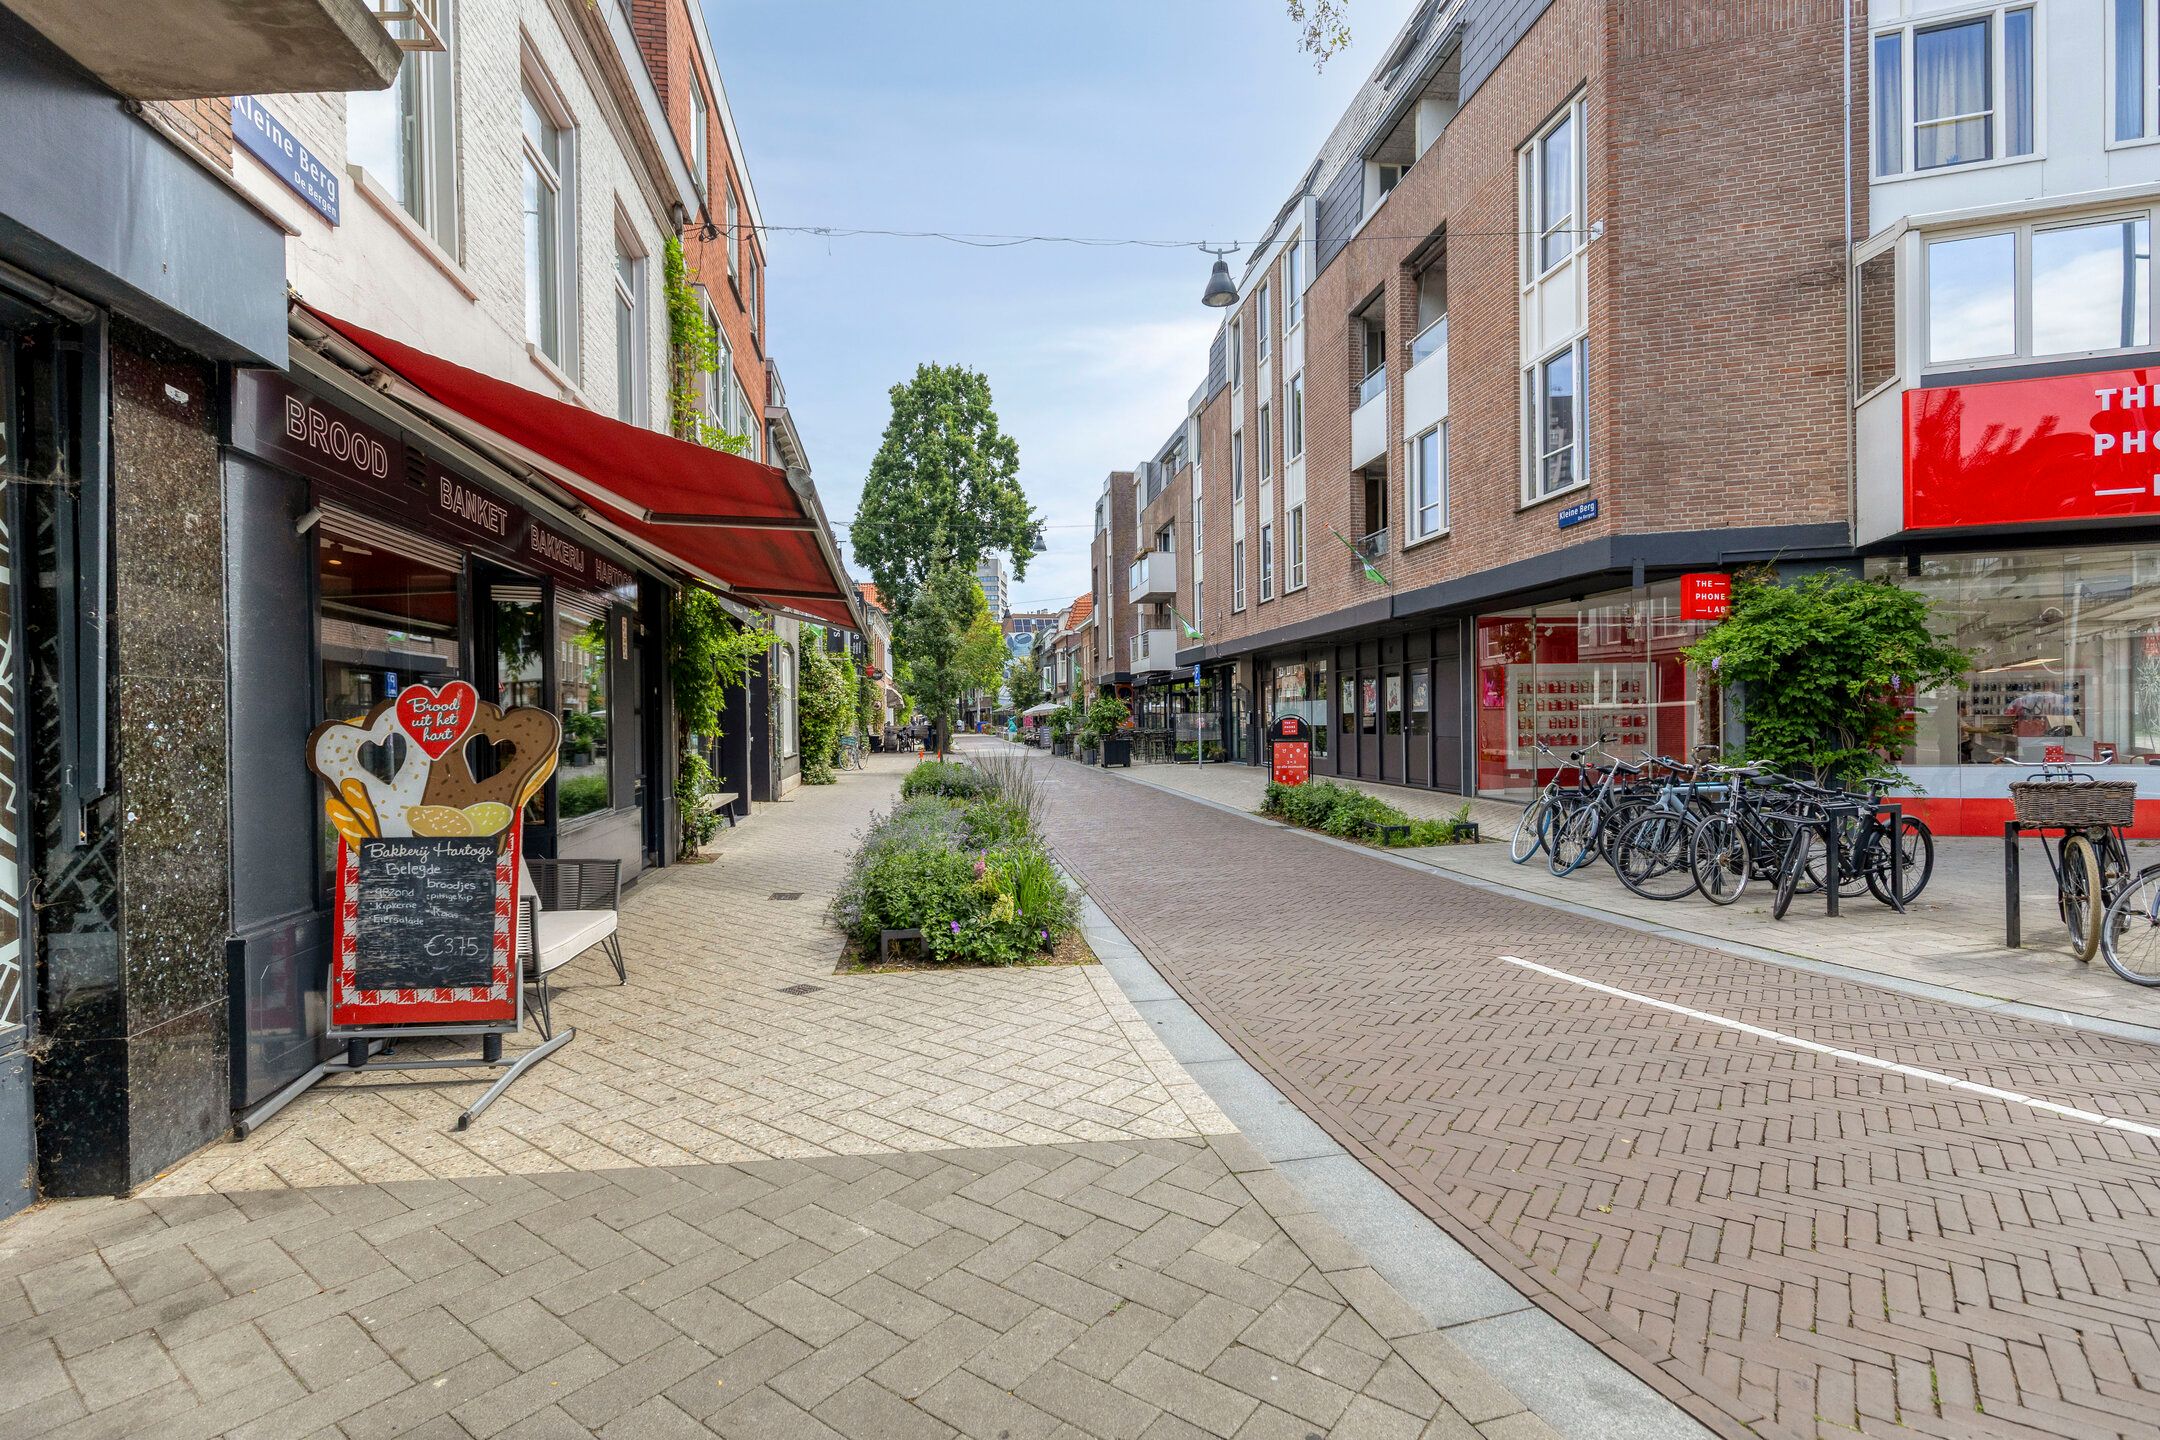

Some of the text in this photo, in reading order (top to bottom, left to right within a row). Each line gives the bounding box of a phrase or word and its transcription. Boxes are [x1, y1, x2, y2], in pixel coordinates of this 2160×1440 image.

[299, 146, 336, 203] Berg
[294, 170, 337, 218] De Bergen
[285, 394, 389, 480] BROOD
[440, 476, 508, 537] BANKET
[530, 524, 585, 573] BAKKERIJ
[1559, 502, 1595, 520] Kleine Berg
[1695, 580, 1713, 588] THE
[406, 697, 460, 713] Brood
[411, 711, 458, 727] uit het
[422, 726, 454, 742] hart
[365, 841, 494, 864] Bakkerij Hartogs
[385, 861, 443, 879] Belegde
[426, 878, 477, 893] broodjes
